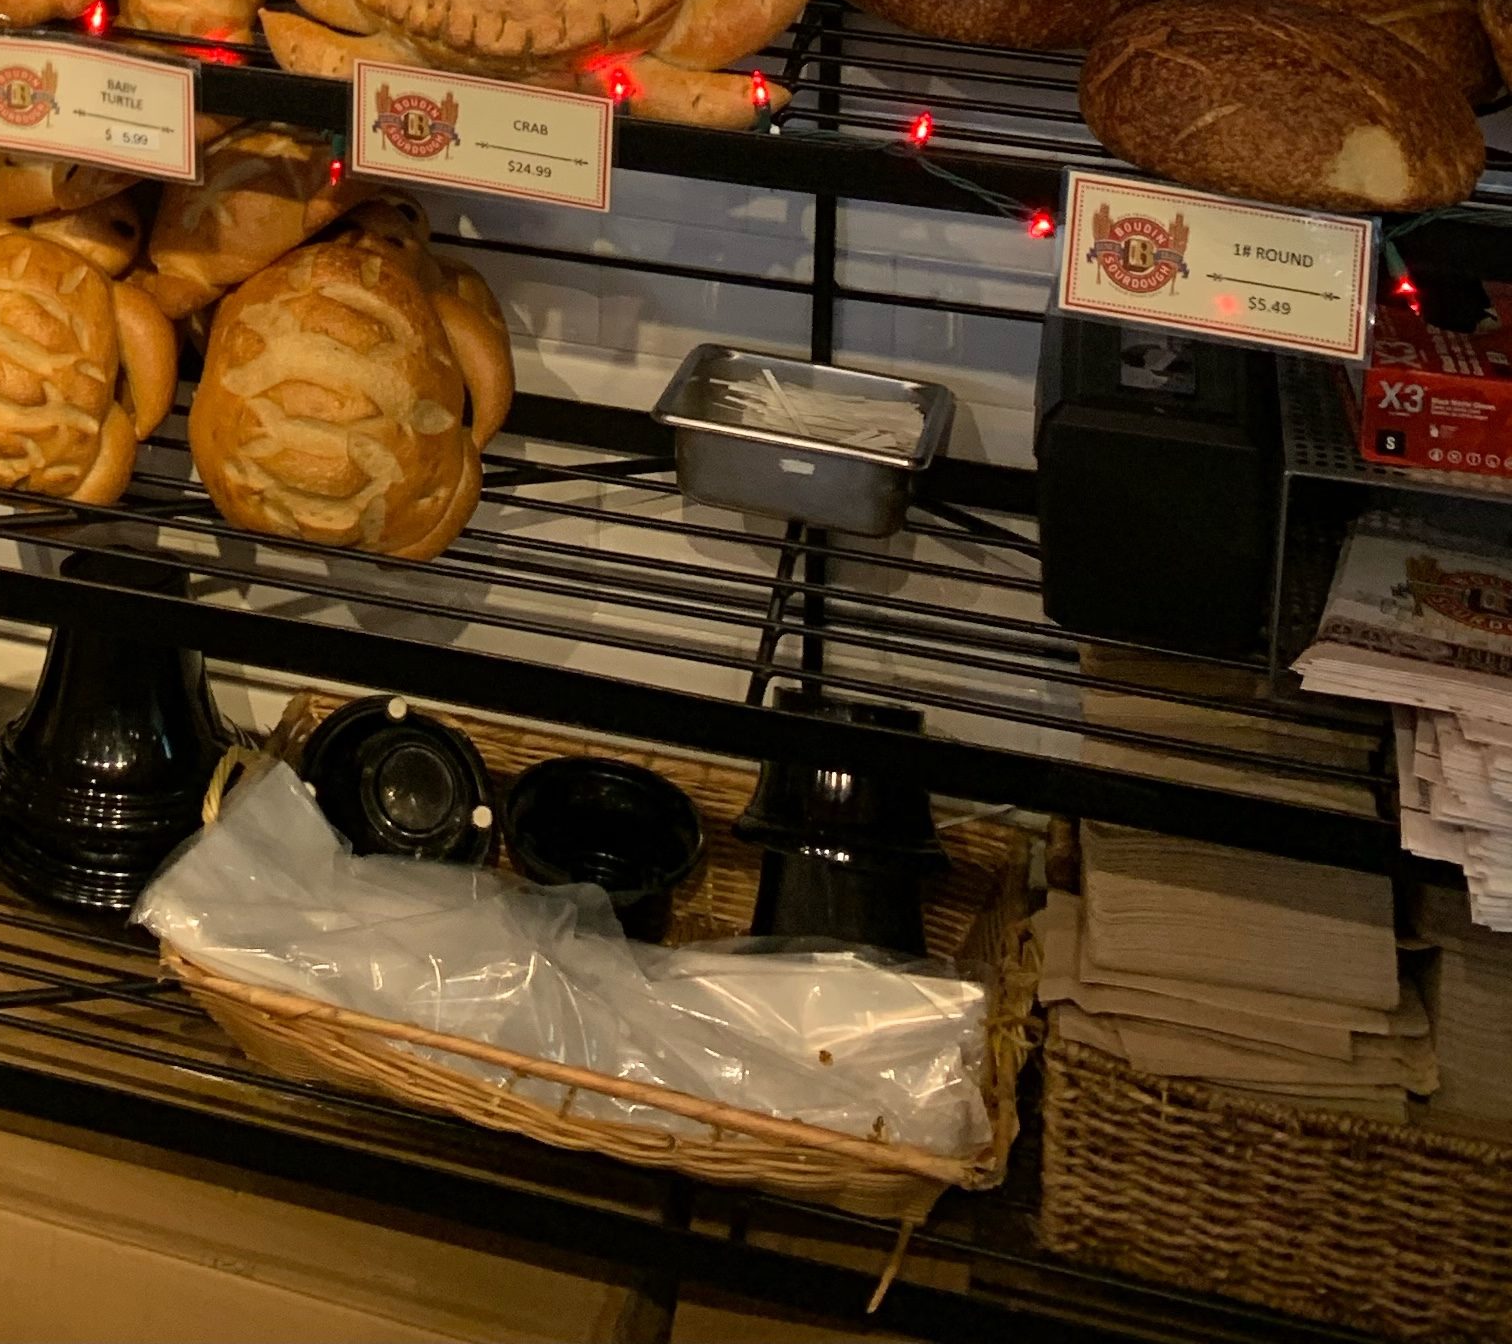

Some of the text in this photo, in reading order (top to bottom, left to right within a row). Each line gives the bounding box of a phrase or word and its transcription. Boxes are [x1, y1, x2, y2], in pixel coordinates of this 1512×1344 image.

[107, 79, 138, 94] BABY
[100, 91, 144, 111] TURTLE
[394, 97, 440, 118] BOUDIN
[513, 119, 549, 136] CRAB
[122, 132, 149, 145] 5.99
[388, 127, 445, 155] SOURDOUGH
[507, 161, 552, 178] $24.99
[1114, 220, 1168, 246] BOUDIN
[1233, 243, 1314, 268] 1# ROUND
[1103, 255, 1171, 289] SOURDOUGH
[1248, 296, 1291, 315] $5.49
[1378, 380, 1425, 413] X3
[1386, 436, 1397, 450] S
